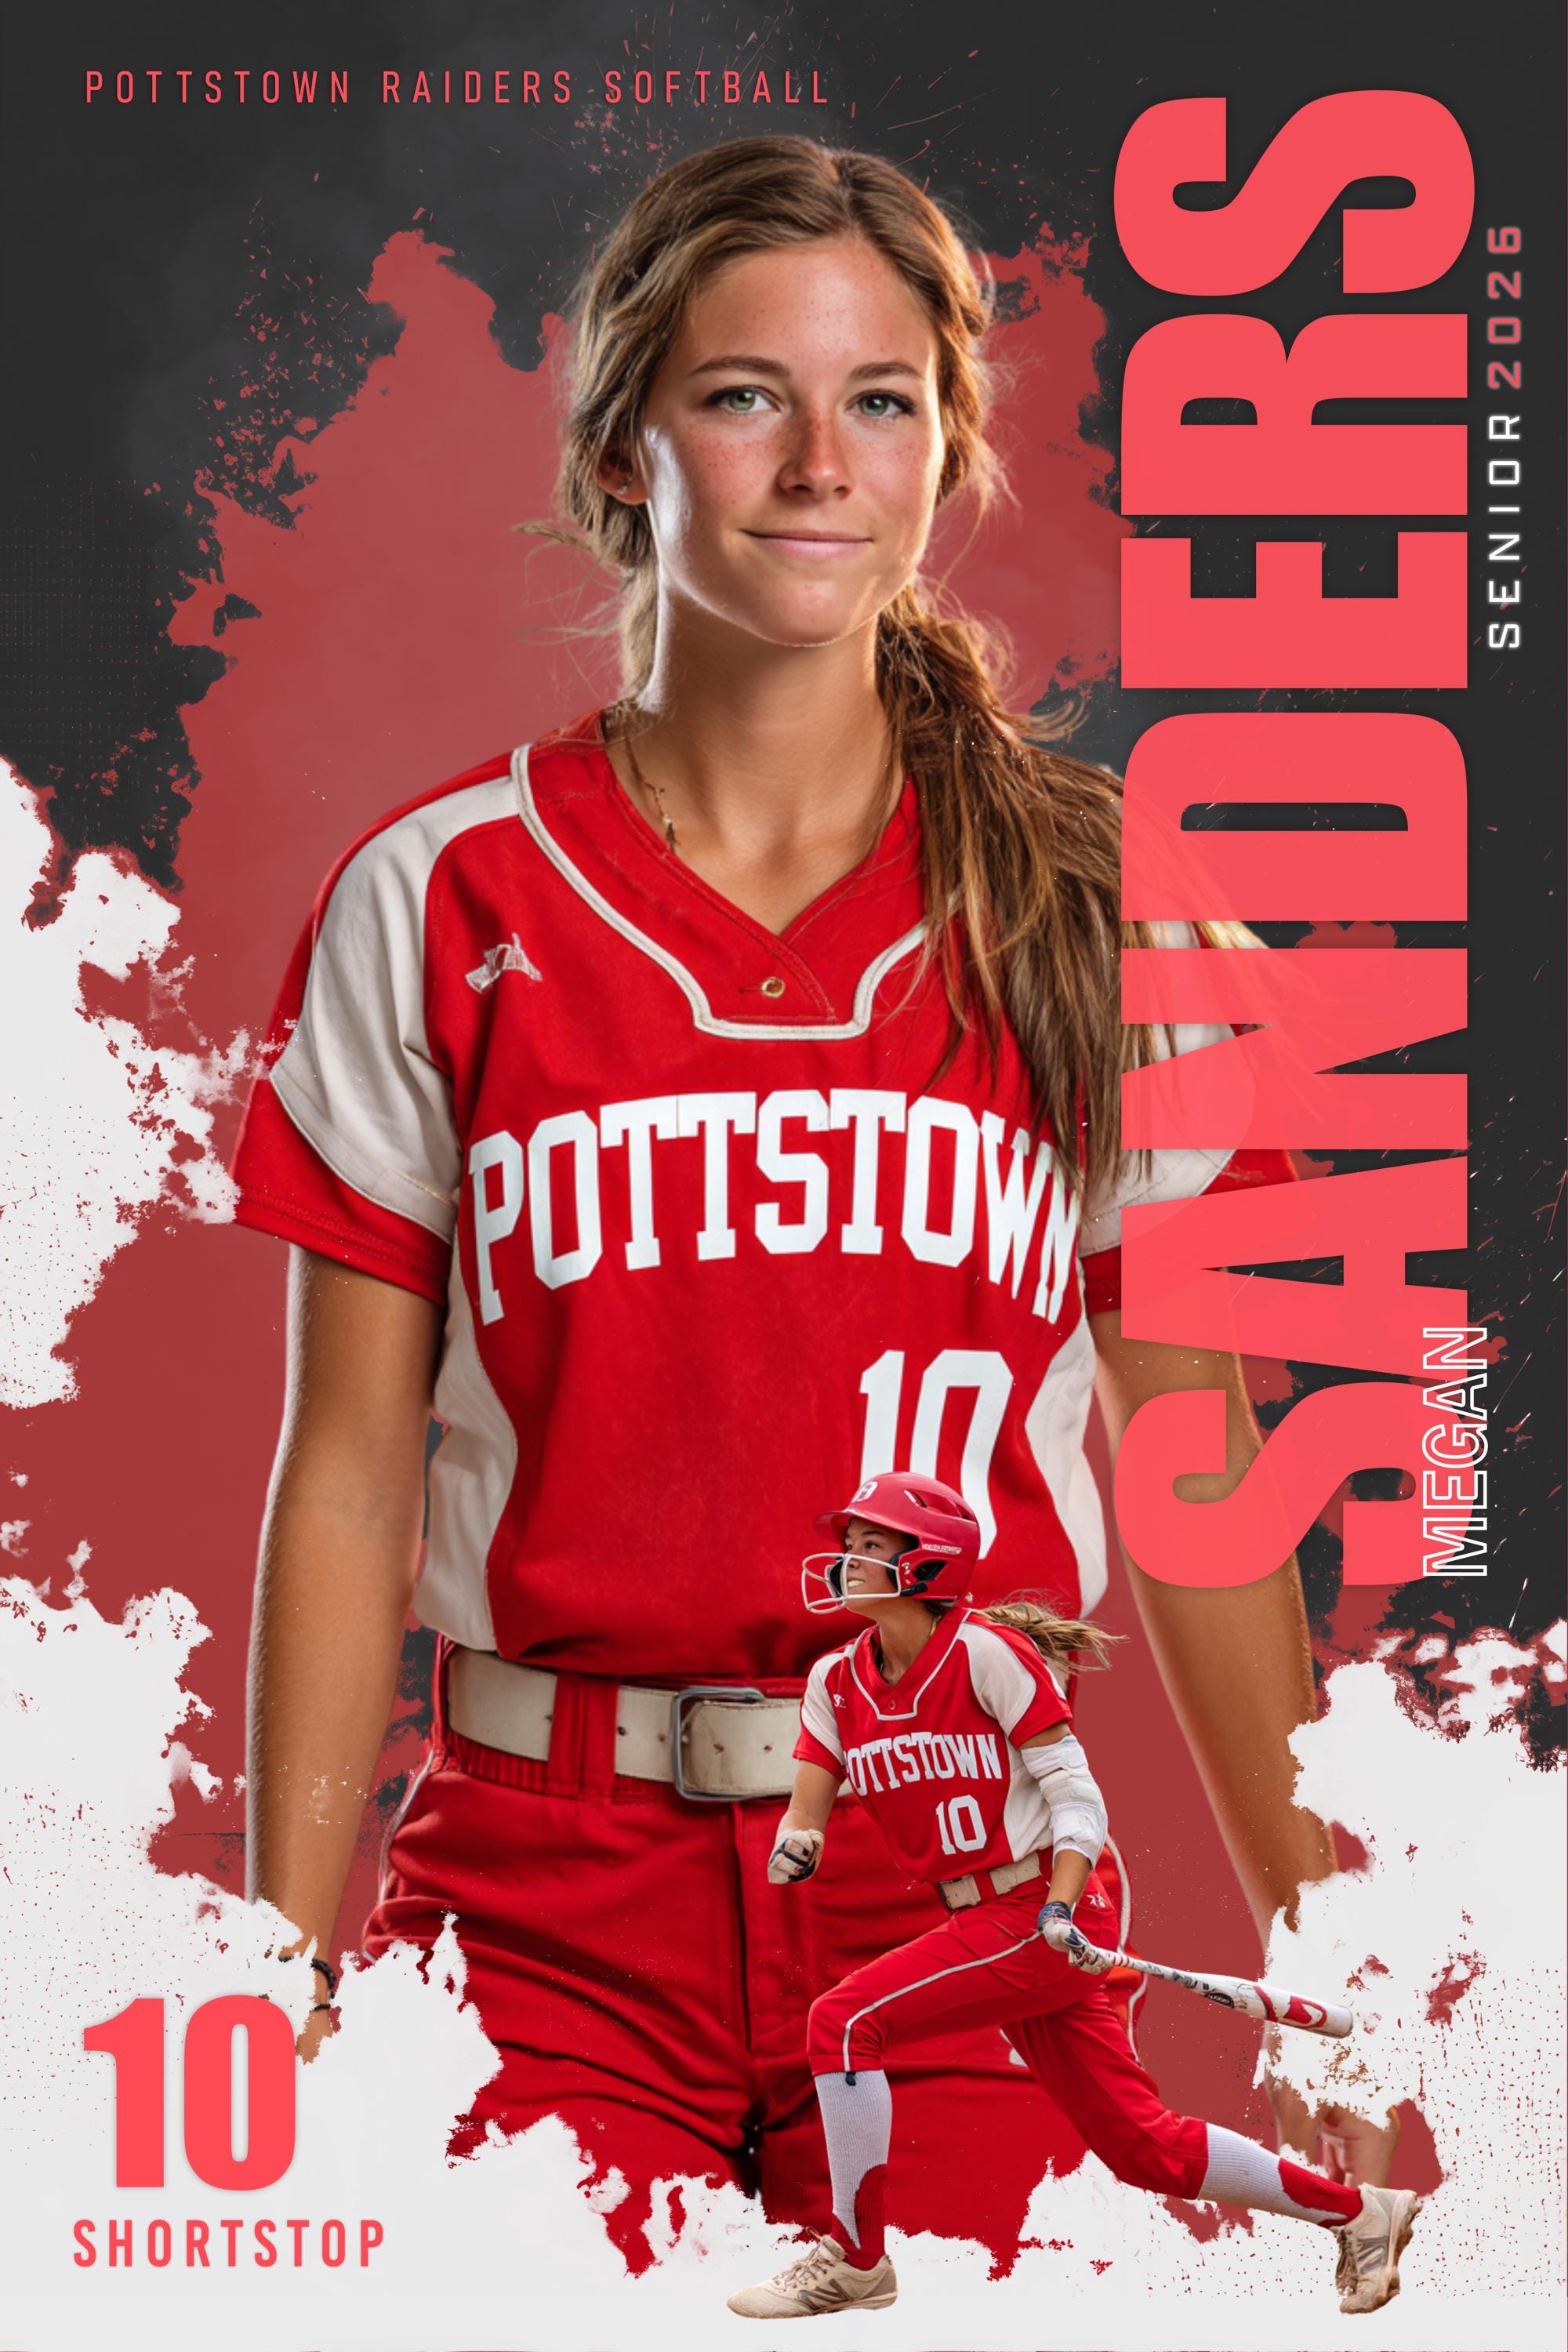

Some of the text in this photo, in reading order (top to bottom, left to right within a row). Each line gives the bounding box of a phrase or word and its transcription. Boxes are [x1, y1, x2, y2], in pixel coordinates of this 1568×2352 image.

[470, 1088, 1081, 1325] POTTSTOWN
[859, 1349, 1014, 1559] 10
[844, 1731, 1004, 1797] OTTSTOWN
[935, 1795, 988, 1856] 10
